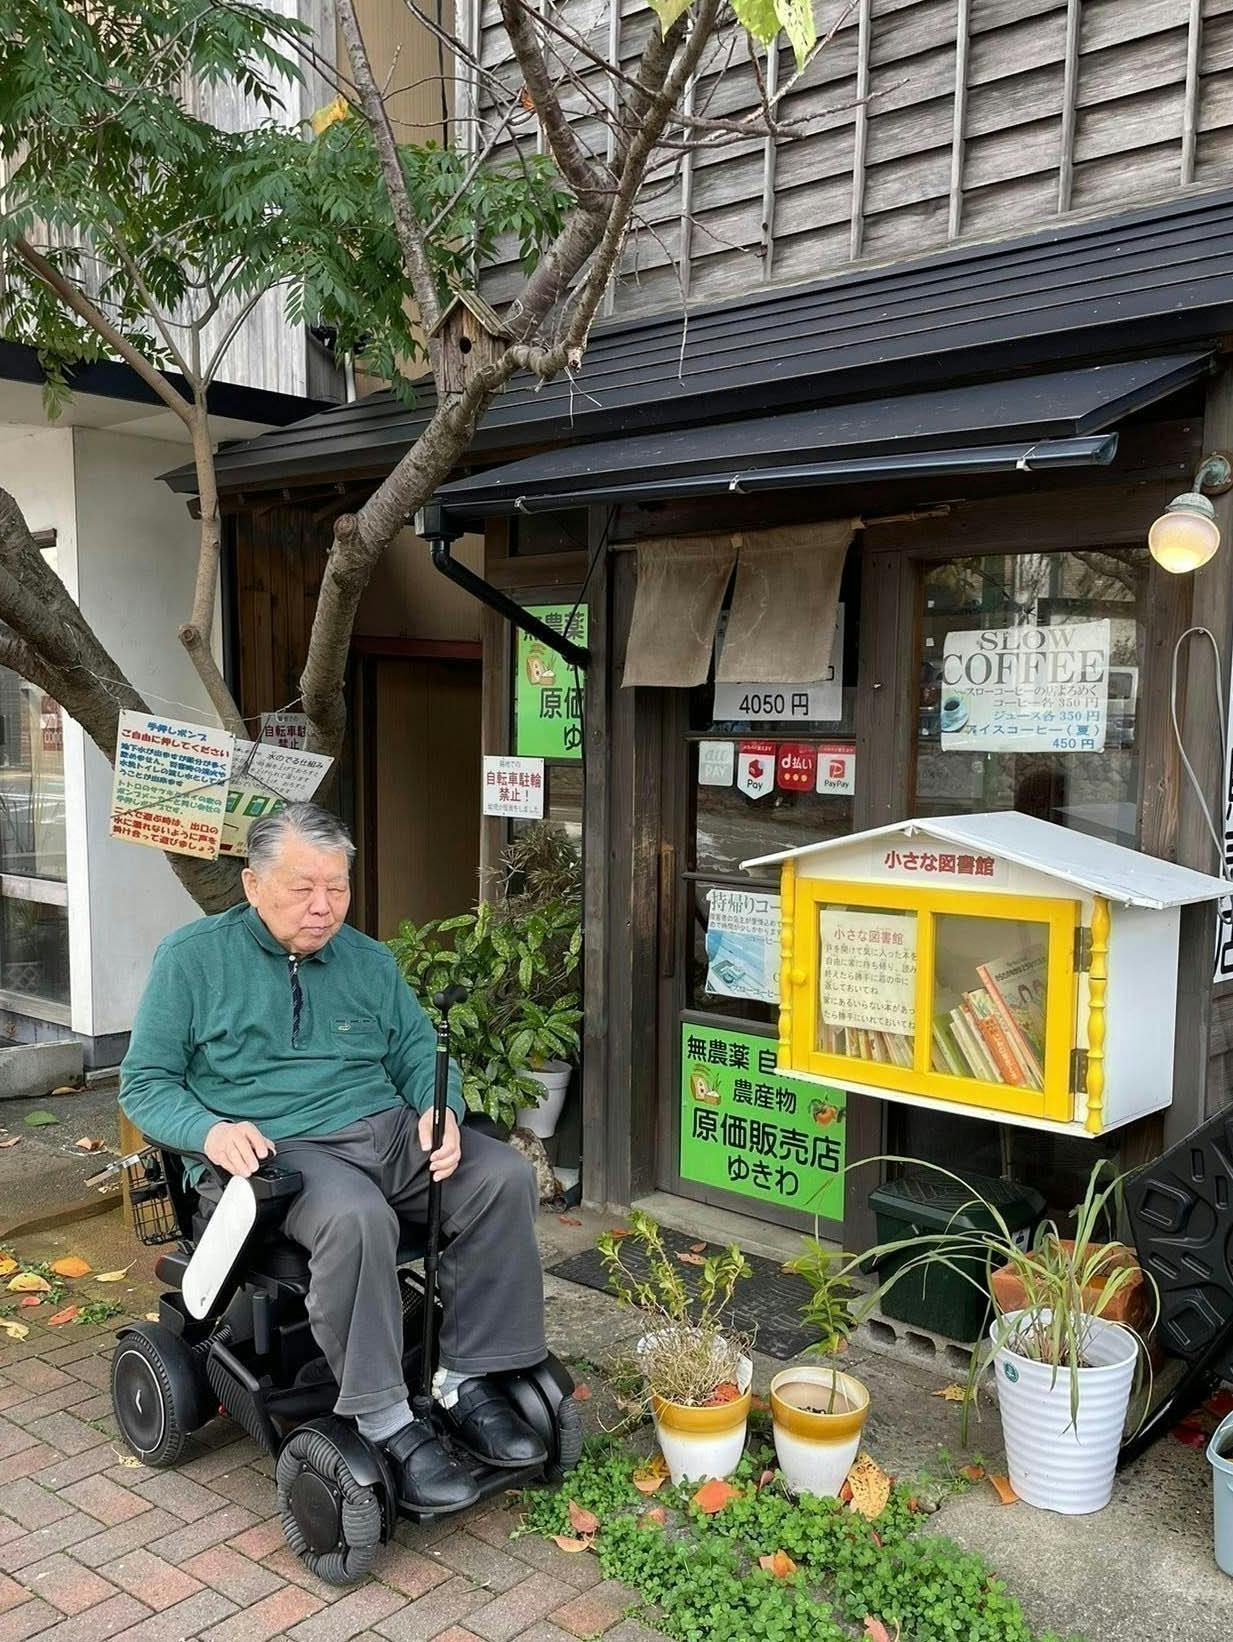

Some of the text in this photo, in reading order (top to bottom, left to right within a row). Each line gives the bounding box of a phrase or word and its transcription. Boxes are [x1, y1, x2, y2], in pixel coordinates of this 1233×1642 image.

[524, 612, 585, 641] 農薬
[979, 629, 1075, 651] SLOW
[943, 650, 1104, 686] COFFEE
[739, 693, 809, 716] 4050 円
[1059, 698, 1081, 708] 350
[1085, 697, 1099, 709] 円
[1059, 710, 1082, 721] 350
[1086, 710, 1100, 722] 円
[121, 728, 230, 758] ご自由に押してください
[1052, 738, 1095, 749] 450 円
[781, 753, 812, 769] d払い
[487, 771, 541, 788] 自転車駐輪
[747, 779, 763, 791] Pay
[824, 780, 849, 789] PayPay
[884, 850, 995, 877] 小さな図書館
[834, 929, 904, 946] 小さな図書館
[687, 1034, 750, 1071] 無農薬
[732, 1078, 797, 1115] 農産物
[692, 1106, 841, 1173] 原価販売店
[727, 1154, 799, 1196] ゆきわ
